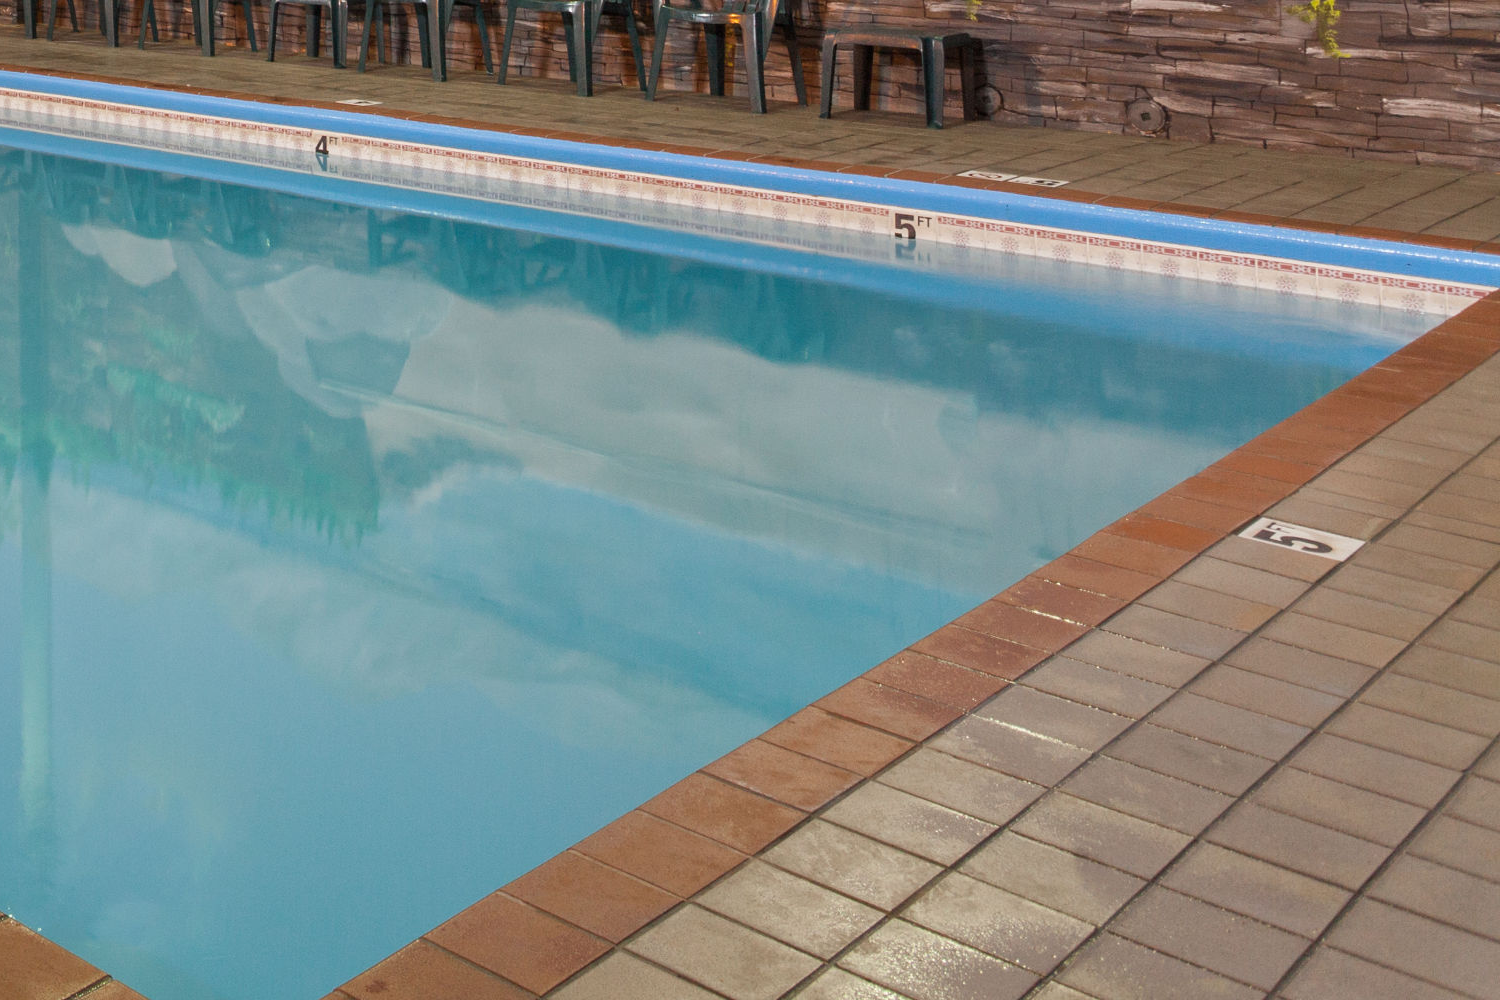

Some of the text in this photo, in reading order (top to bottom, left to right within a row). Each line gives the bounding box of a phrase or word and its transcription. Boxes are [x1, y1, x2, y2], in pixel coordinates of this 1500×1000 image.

[315, 136, 338, 154] 4 FT
[895, 213, 932, 239] 5 FT
[1252, 529, 1333, 554] 5
